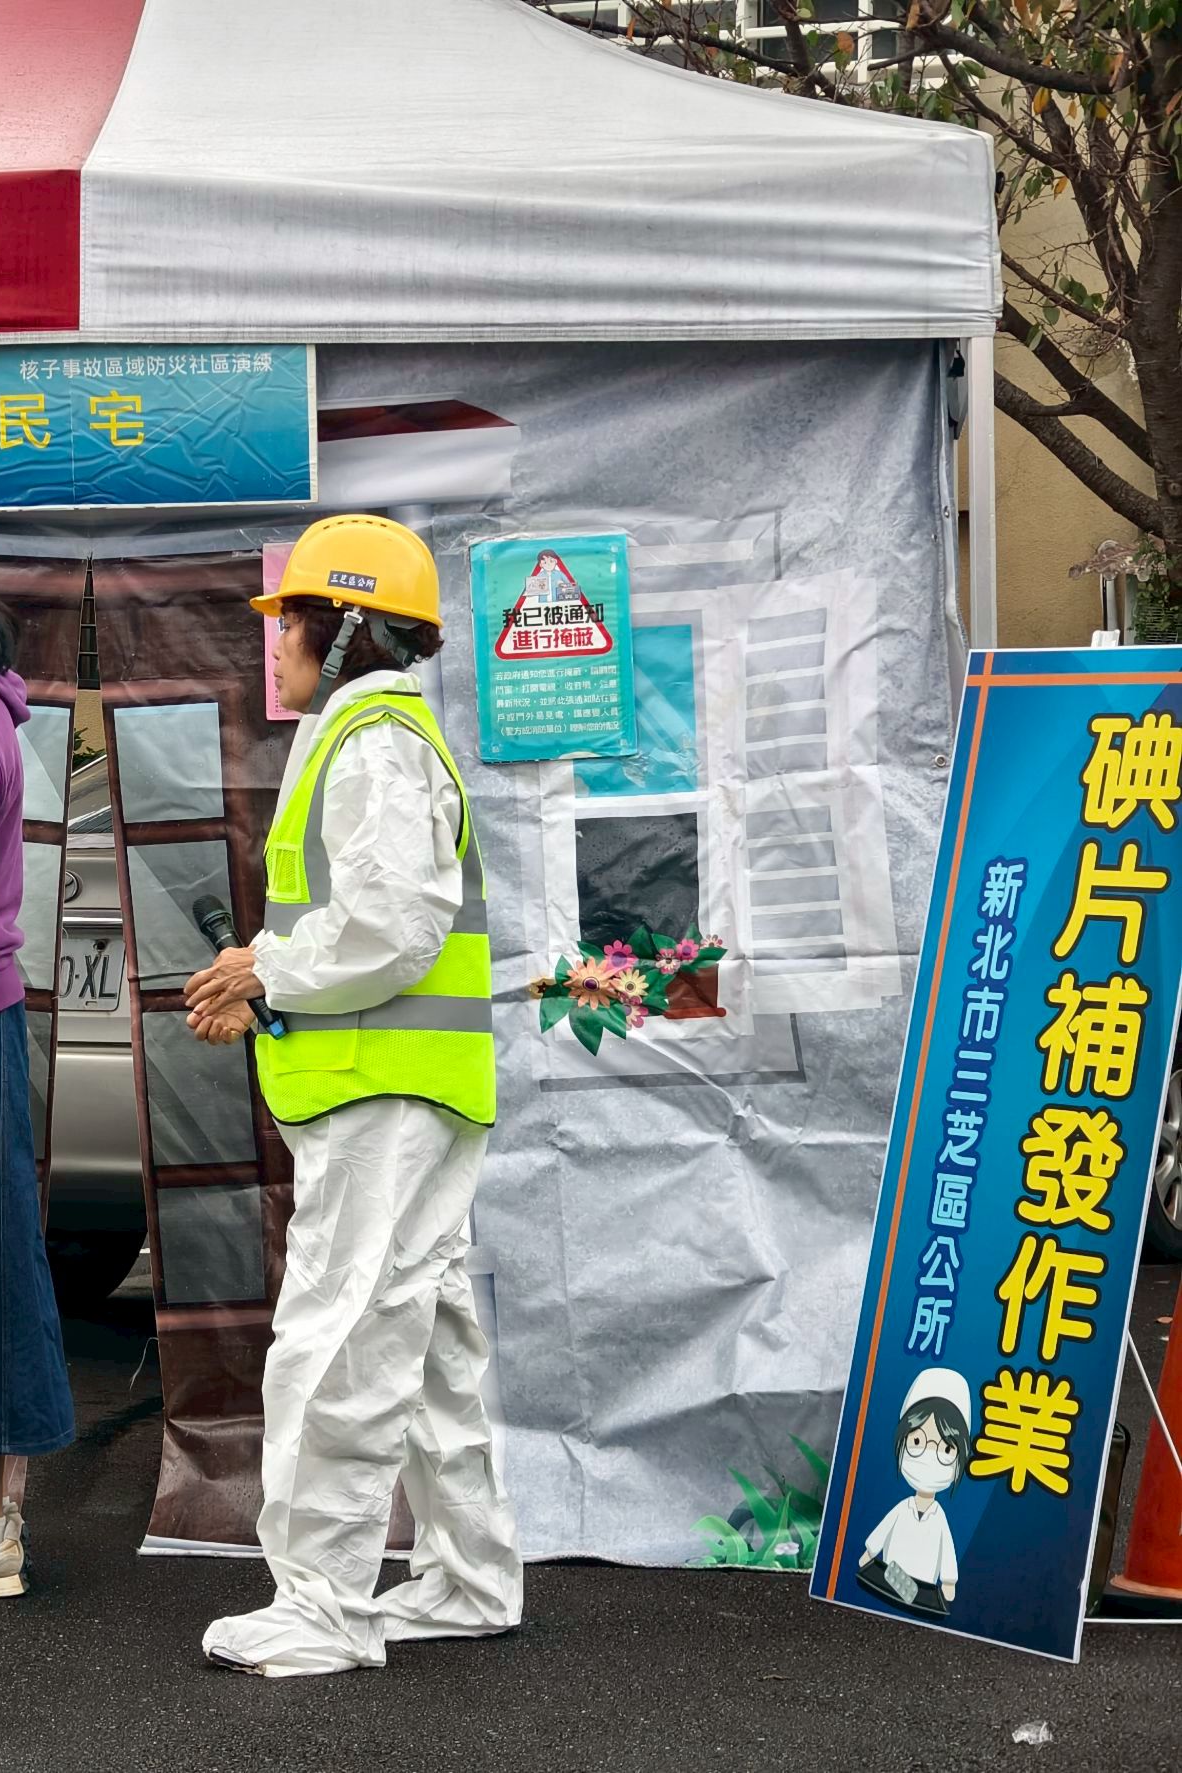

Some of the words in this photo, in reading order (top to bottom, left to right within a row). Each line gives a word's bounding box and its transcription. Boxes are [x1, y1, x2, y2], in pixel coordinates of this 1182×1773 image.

[19, 351, 274, 380] 核子事故區域防災社區演練
[502, 602, 605, 628] 我已被通知
[512, 626, 594, 651] 進行掩蔽
[908, 862, 1026, 1355] 新北市三芝區公所
[970, 713, 1182, 1496] 碘片補發作業
